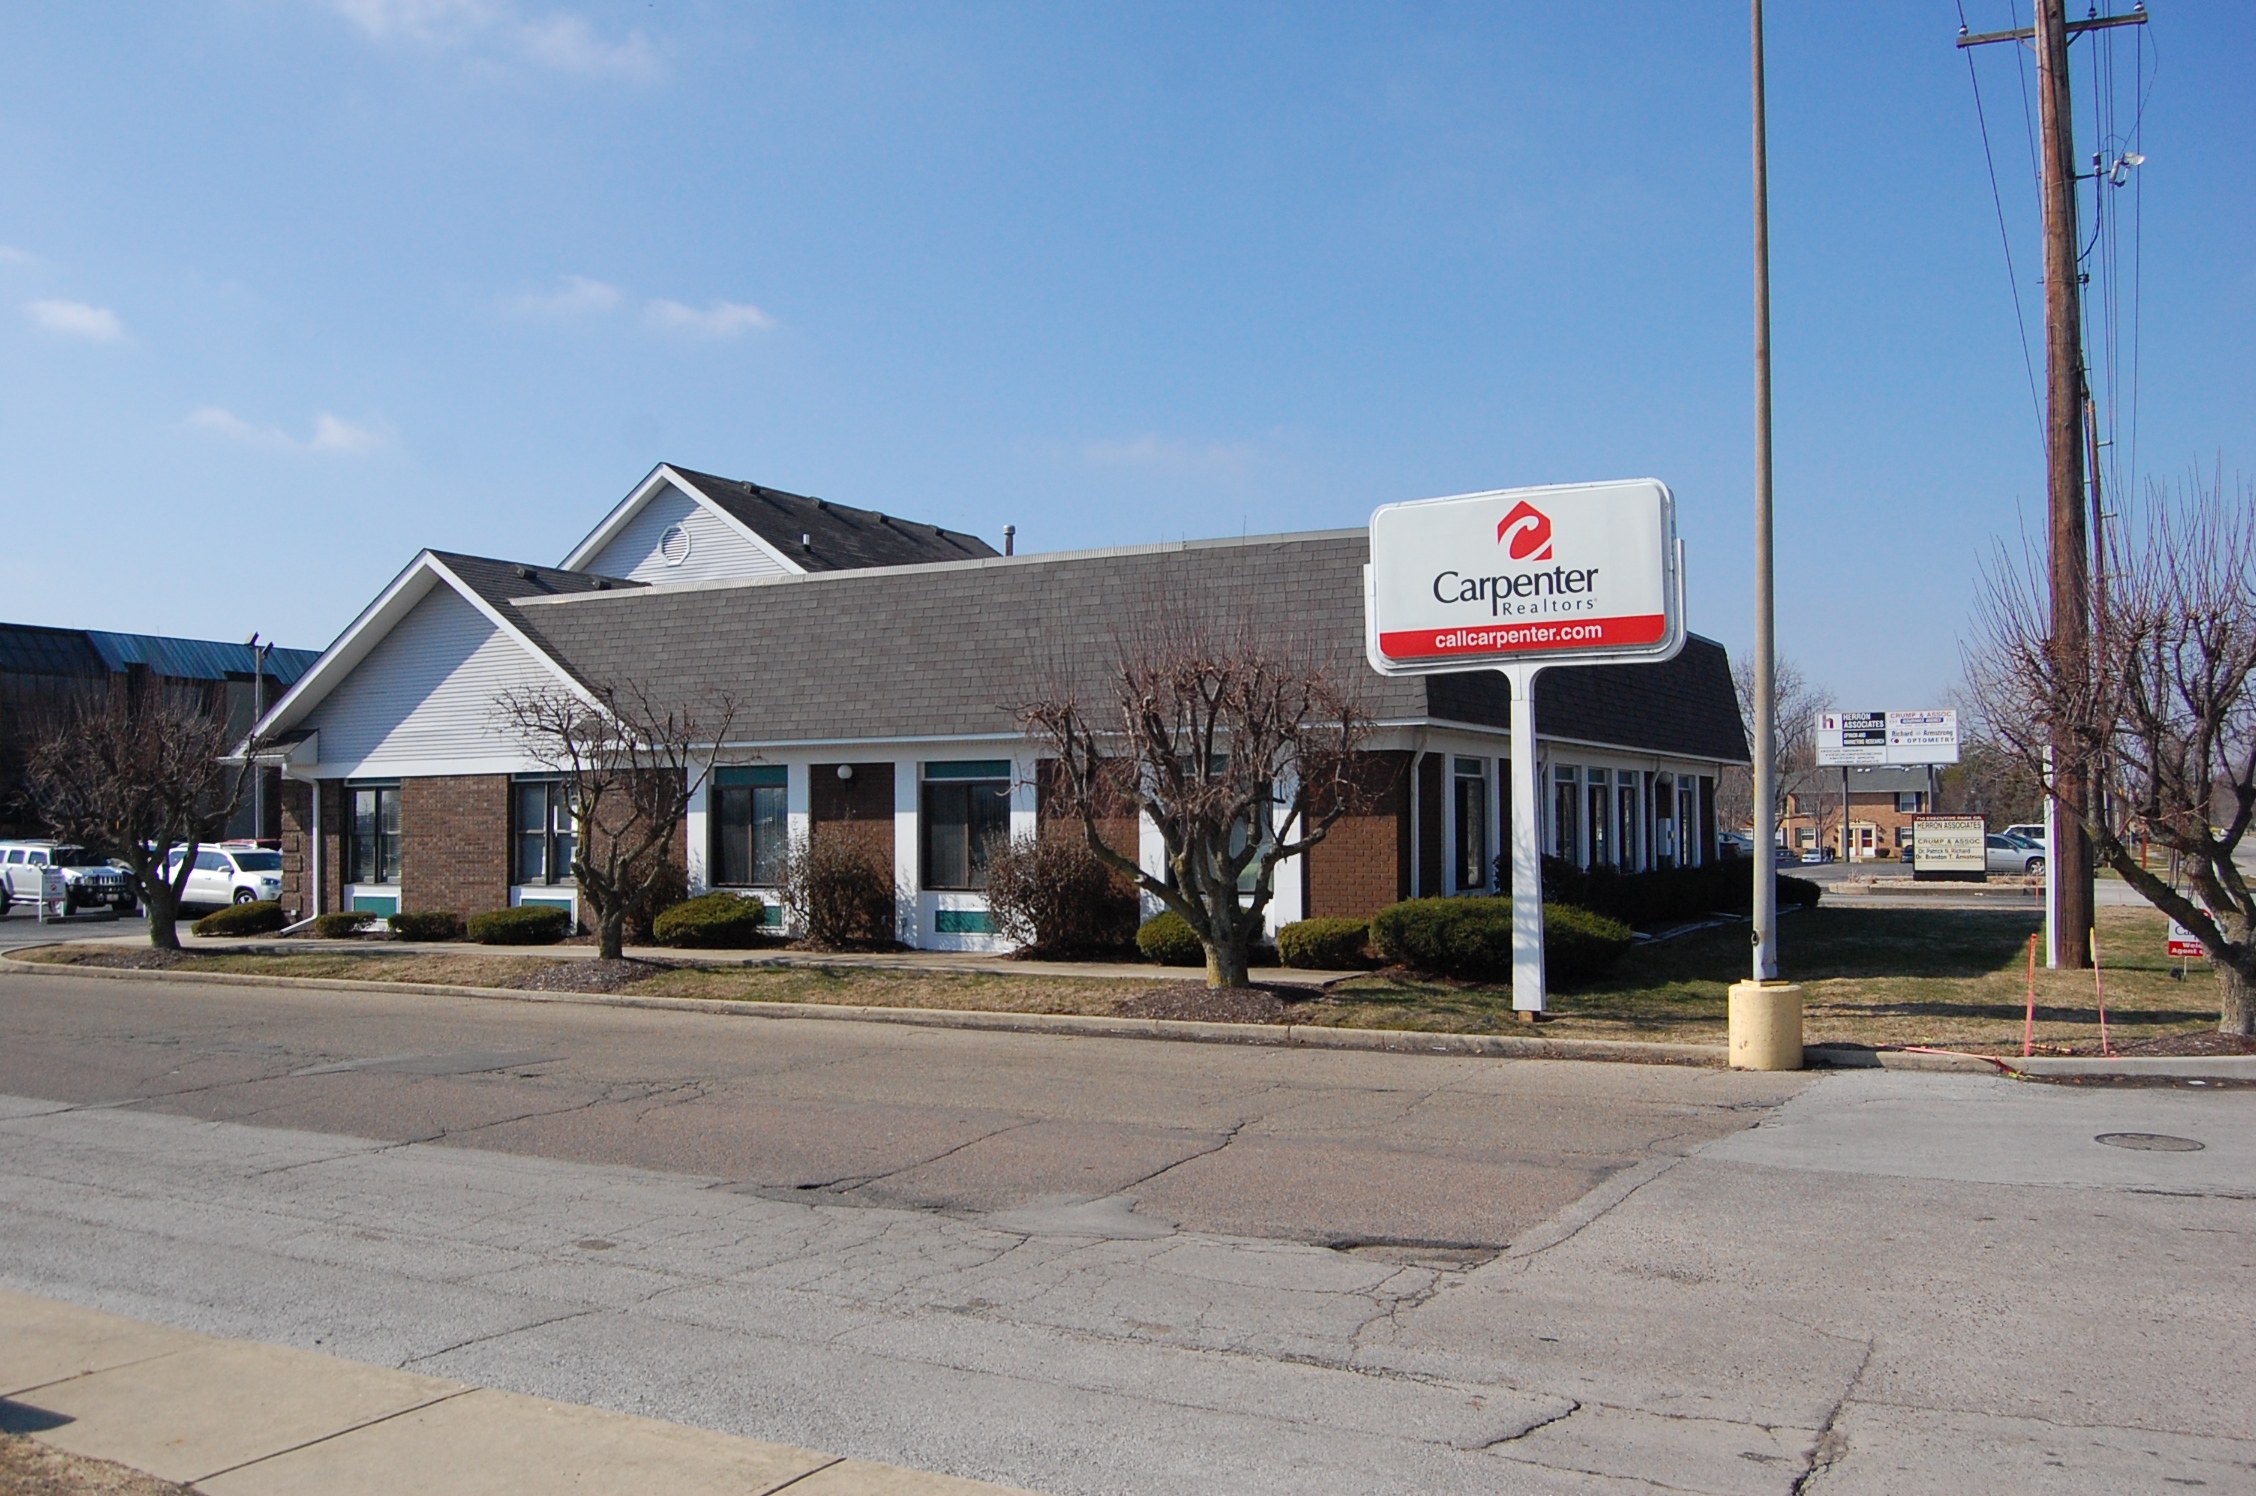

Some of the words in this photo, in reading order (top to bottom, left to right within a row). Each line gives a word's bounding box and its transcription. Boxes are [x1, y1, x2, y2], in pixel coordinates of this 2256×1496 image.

[1433, 565, 1599, 616] Carpenter
[1435, 624, 1602, 648] callcarpenter.com
[1843, 720, 1884, 728] ASSOCIATES
[1944, 821, 1982, 829] ASSOCIATES
